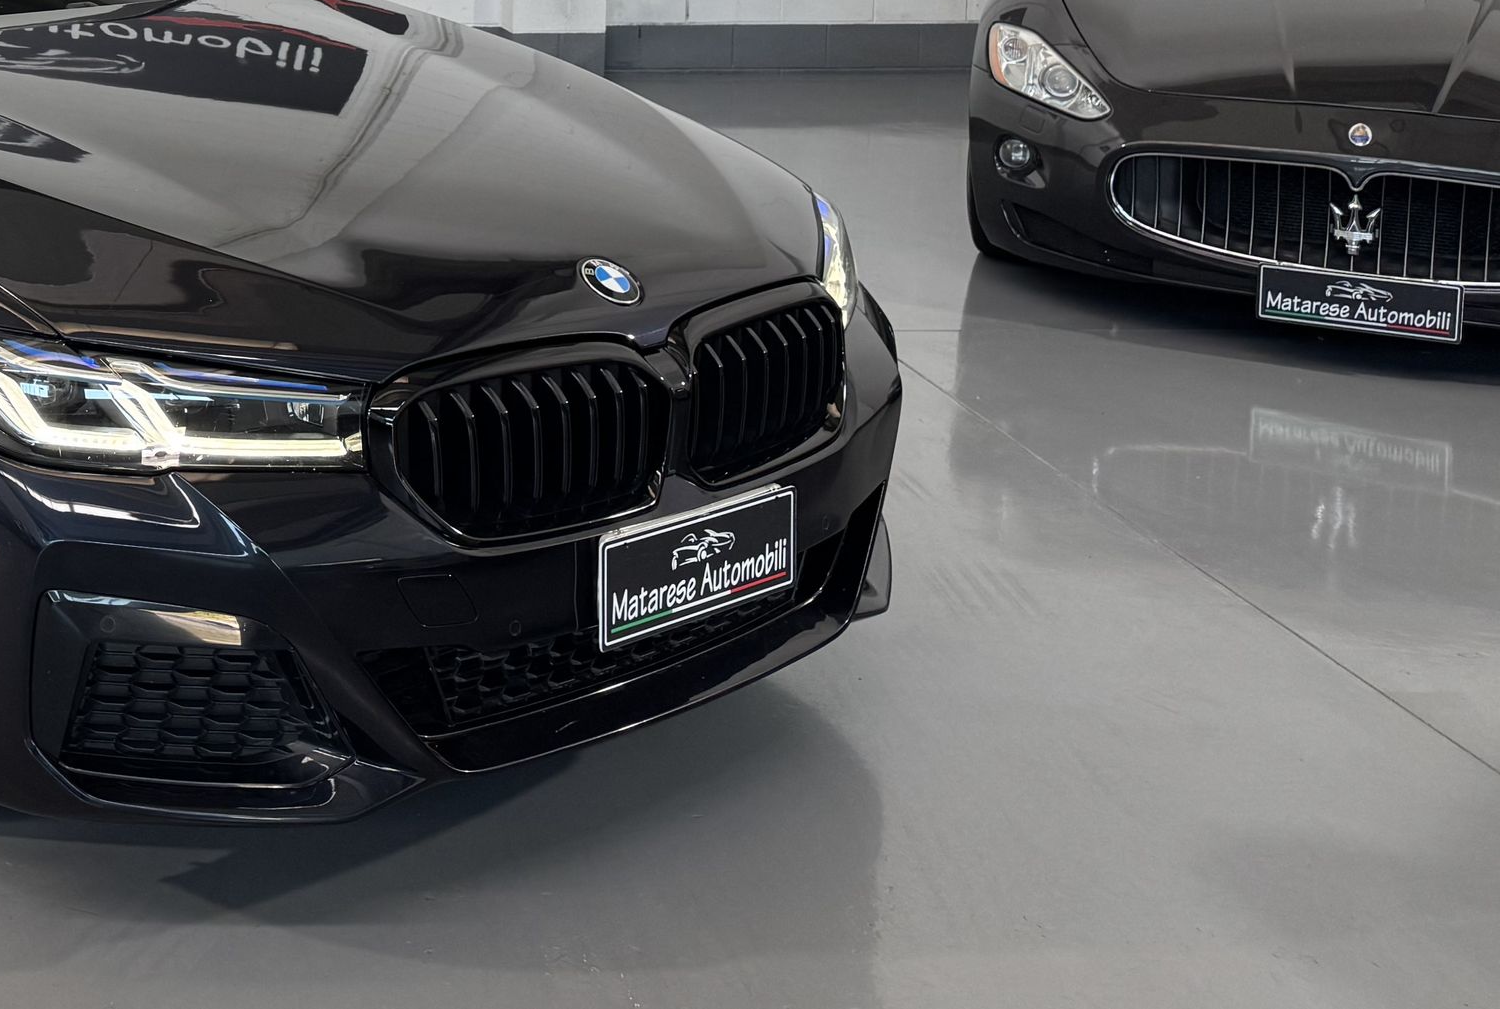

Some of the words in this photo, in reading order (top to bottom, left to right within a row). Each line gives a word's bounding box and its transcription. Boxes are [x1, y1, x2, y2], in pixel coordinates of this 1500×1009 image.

[1266, 290, 1350, 318] Matarese
[1354, 301, 1452, 331] Automobili
[611, 576, 697, 626] Matarese
[700, 537, 787, 597] Automobili
